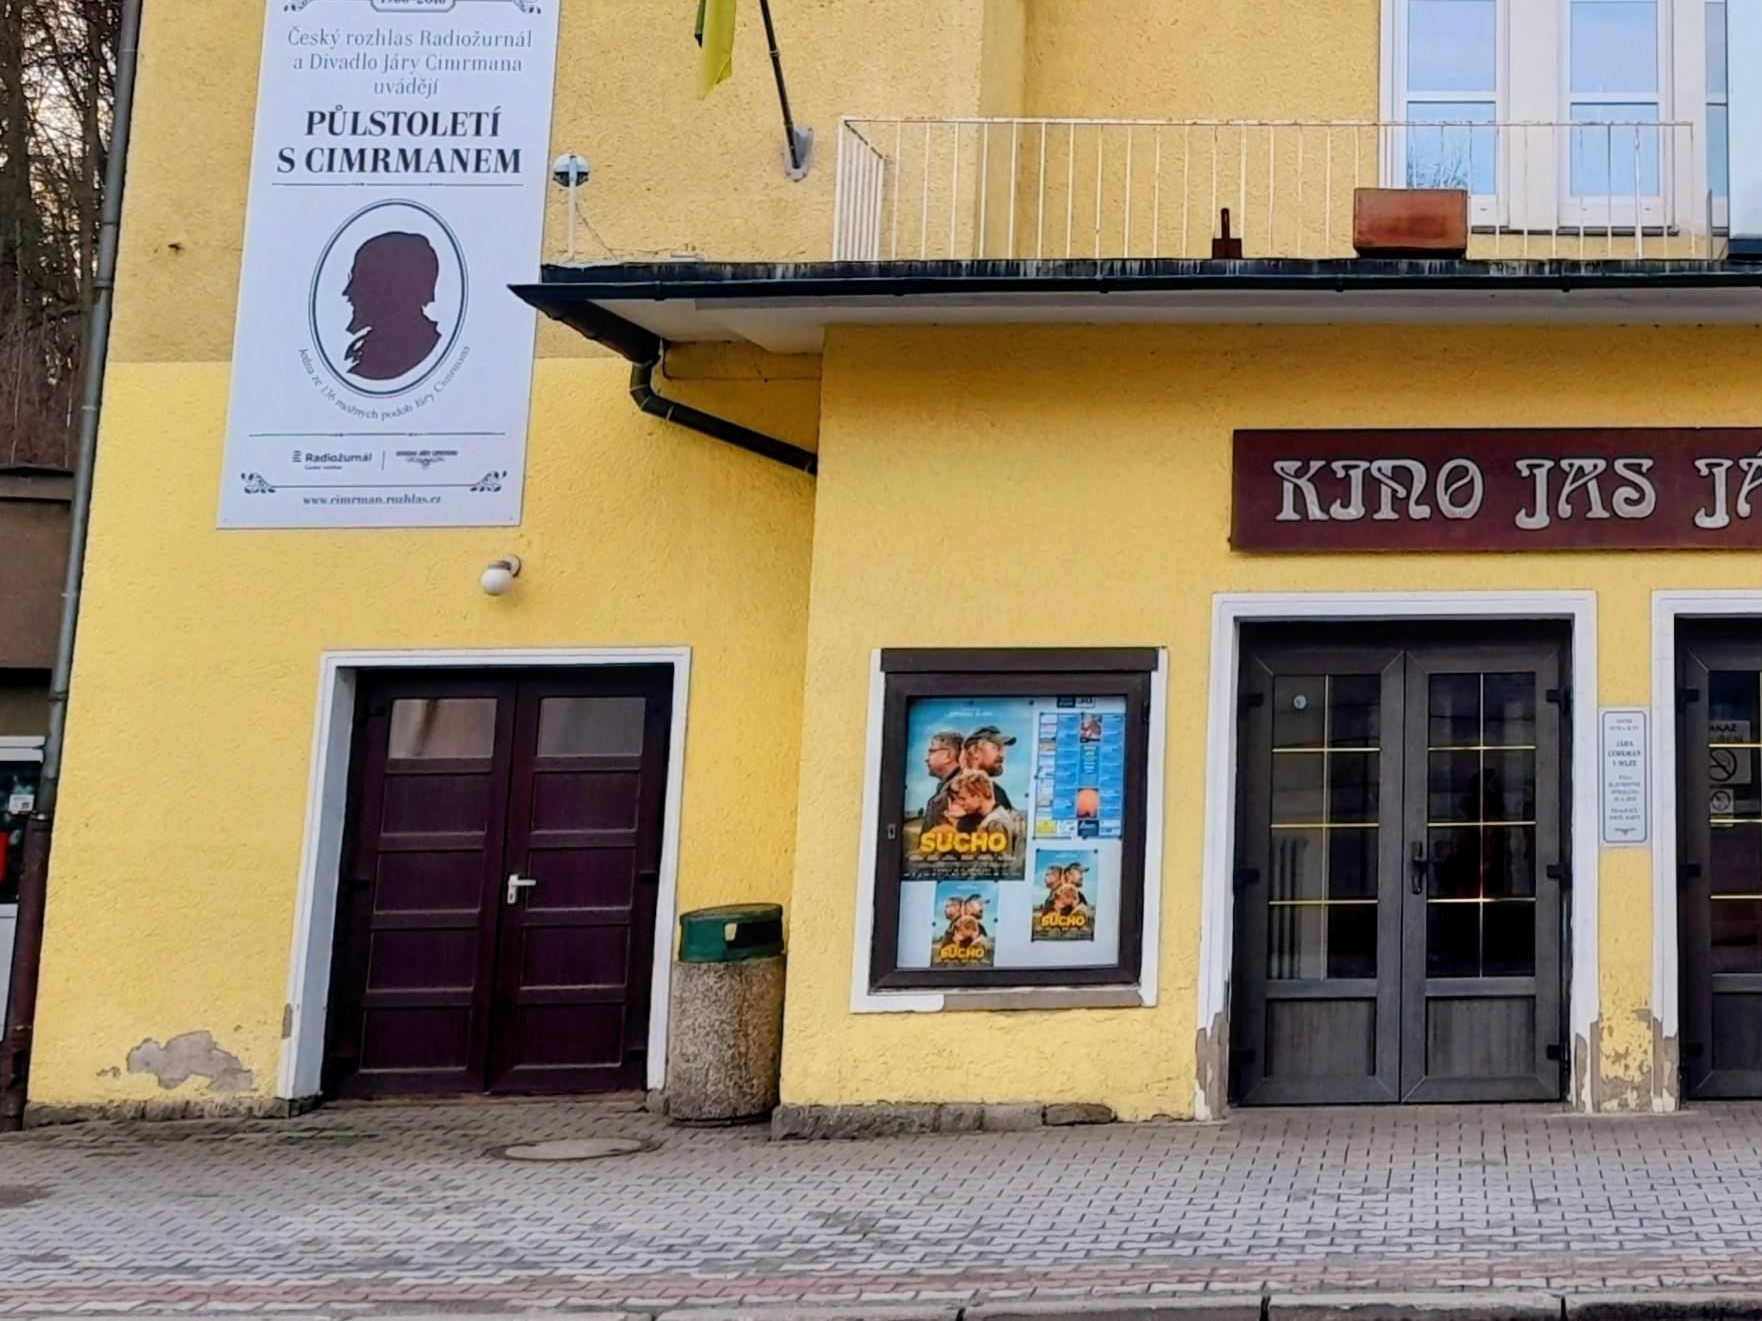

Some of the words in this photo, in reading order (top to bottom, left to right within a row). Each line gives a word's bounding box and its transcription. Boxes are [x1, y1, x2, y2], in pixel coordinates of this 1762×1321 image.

[288, 26, 340, 49] Český
[346, 27, 413, 47] rozhlas
[420, 28, 532, 48] Radiožurnál
[293, 58, 303, 70] a
[309, 52, 378, 70] Divadlo
[382, 53, 418, 75] Járy
[425, 53, 522, 71] Cimrmana
[373, 77, 439, 98] uvádějí
[305, 105, 502, 137] PŮLSTOLETÍ
[277, 147, 296, 174] S
[305, 147, 522, 174] CIMRMANEM
[298, 348, 315, 375] Jedna
[312, 375, 323, 387] ze
[336, 399, 379, 420] možných
[381, 404, 413, 422] podob
[415, 392, 436, 409] Járy
[434, 345, 471, 392] Cimrmana
[305, 452, 373, 463] Radiožurnál
[303, 494, 441, 505] www.cimrman.rozhlas.cz
[1273, 458, 1484, 522] KINO
[1514, 458, 1658, 530] JAS
[921, 832, 1007, 853] SUCHO
[1041, 915, 1085, 927] SUCHO
[940, 947, 985, 960] SUCHO
